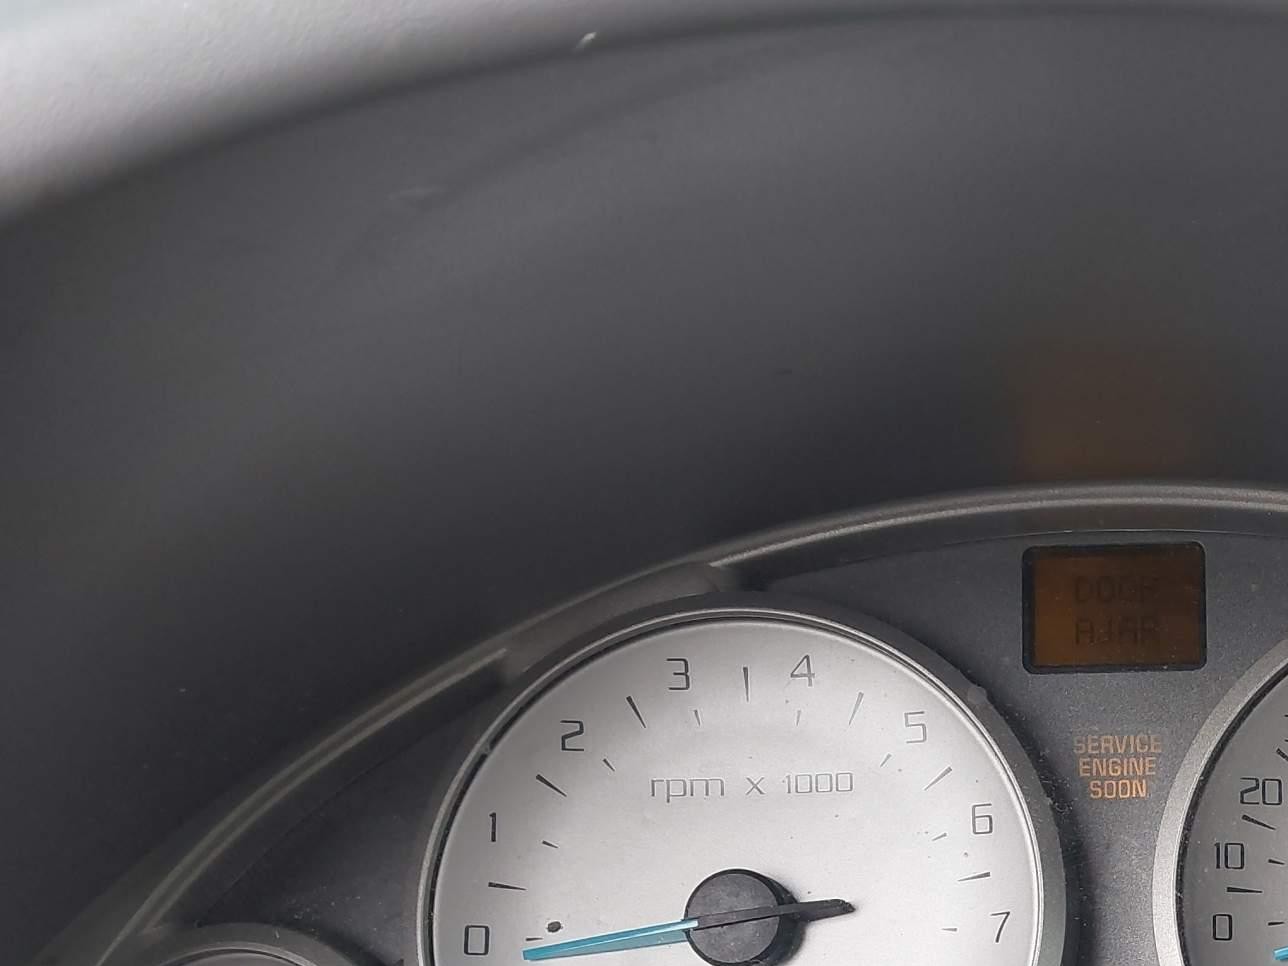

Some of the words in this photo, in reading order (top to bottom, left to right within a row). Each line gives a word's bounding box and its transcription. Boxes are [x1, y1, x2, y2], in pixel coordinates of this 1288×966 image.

[667, 658, 690, 690] 3
[790, 655, 815, 686] 4
[561, 720, 584, 751] 2
[904, 711, 927, 743] 5
[1074, 735, 1161, 754] SERVICE
[1079, 757, 1156, 777] ENGINE
[651, 779, 724, 803] rpm
[746, 777, 765, 795] x
[786, 772, 853, 793] 1000
[1090, 780, 1147, 799] SOON
[1240, 778, 1282, 805] 20
[489, 813, 496, 842] 1
[972, 803, 993, 834] 6
[1215, 843, 1244, 869] 10
[464, 925, 489, 955] 0
[991, 911, 1010, 943] 7
[1213, 914, 1232, 941] 0
